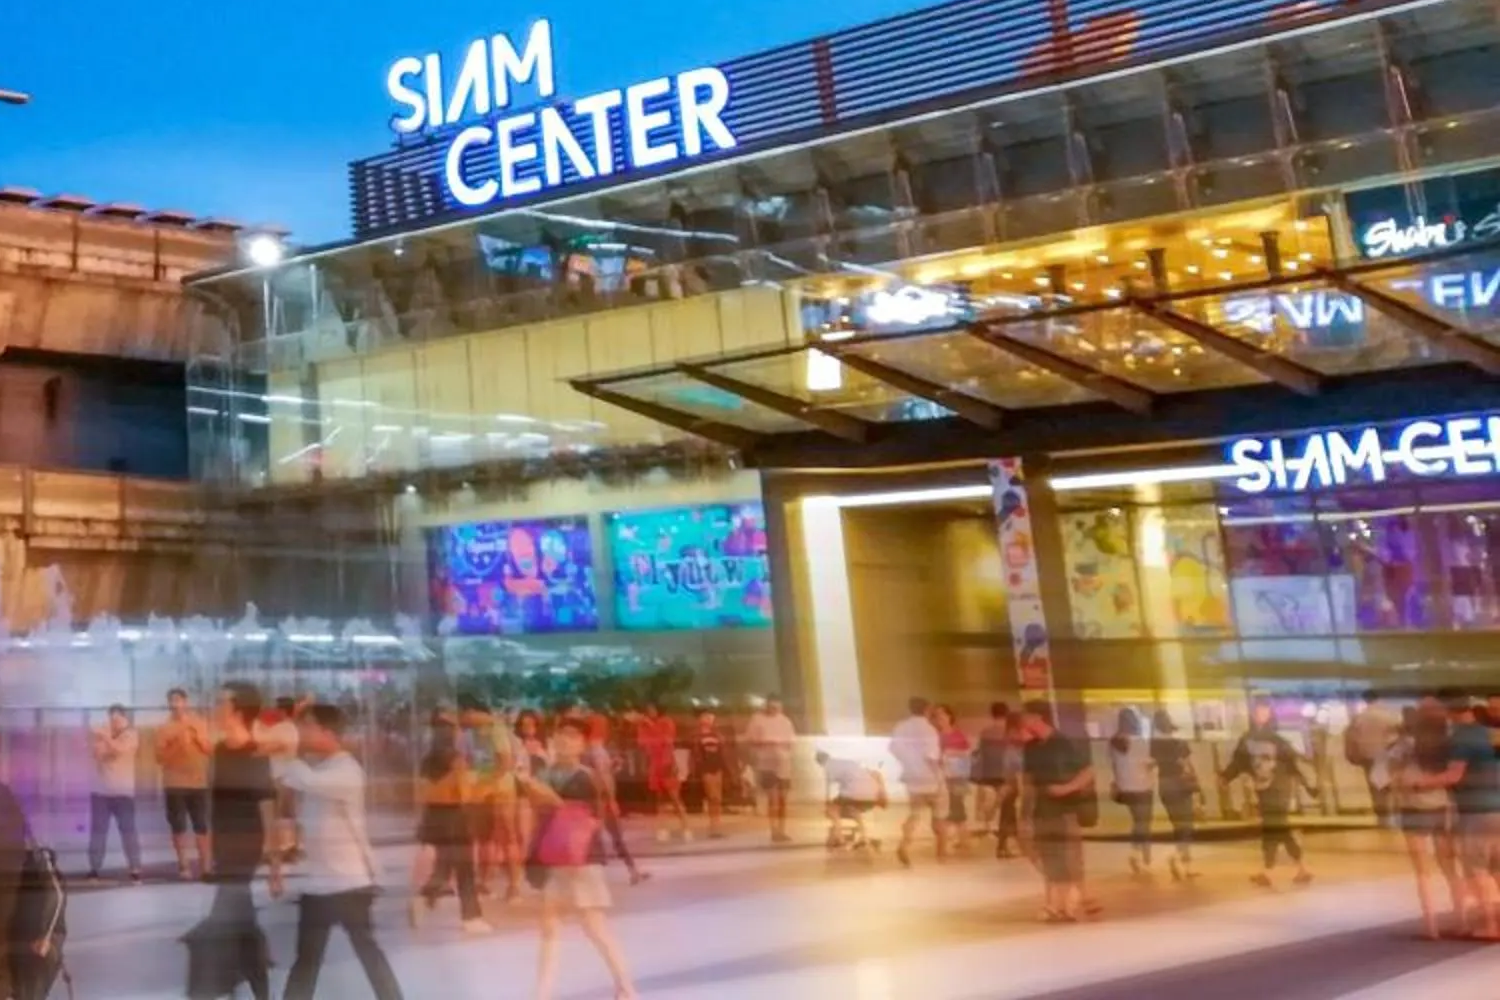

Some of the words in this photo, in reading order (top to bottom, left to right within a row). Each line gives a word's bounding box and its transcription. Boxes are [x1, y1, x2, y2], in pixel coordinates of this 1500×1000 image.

[386, 16, 555, 134] SIAM
[445, 66, 737, 206] CENTER
[1231, 427, 1386, 493] SIAM
